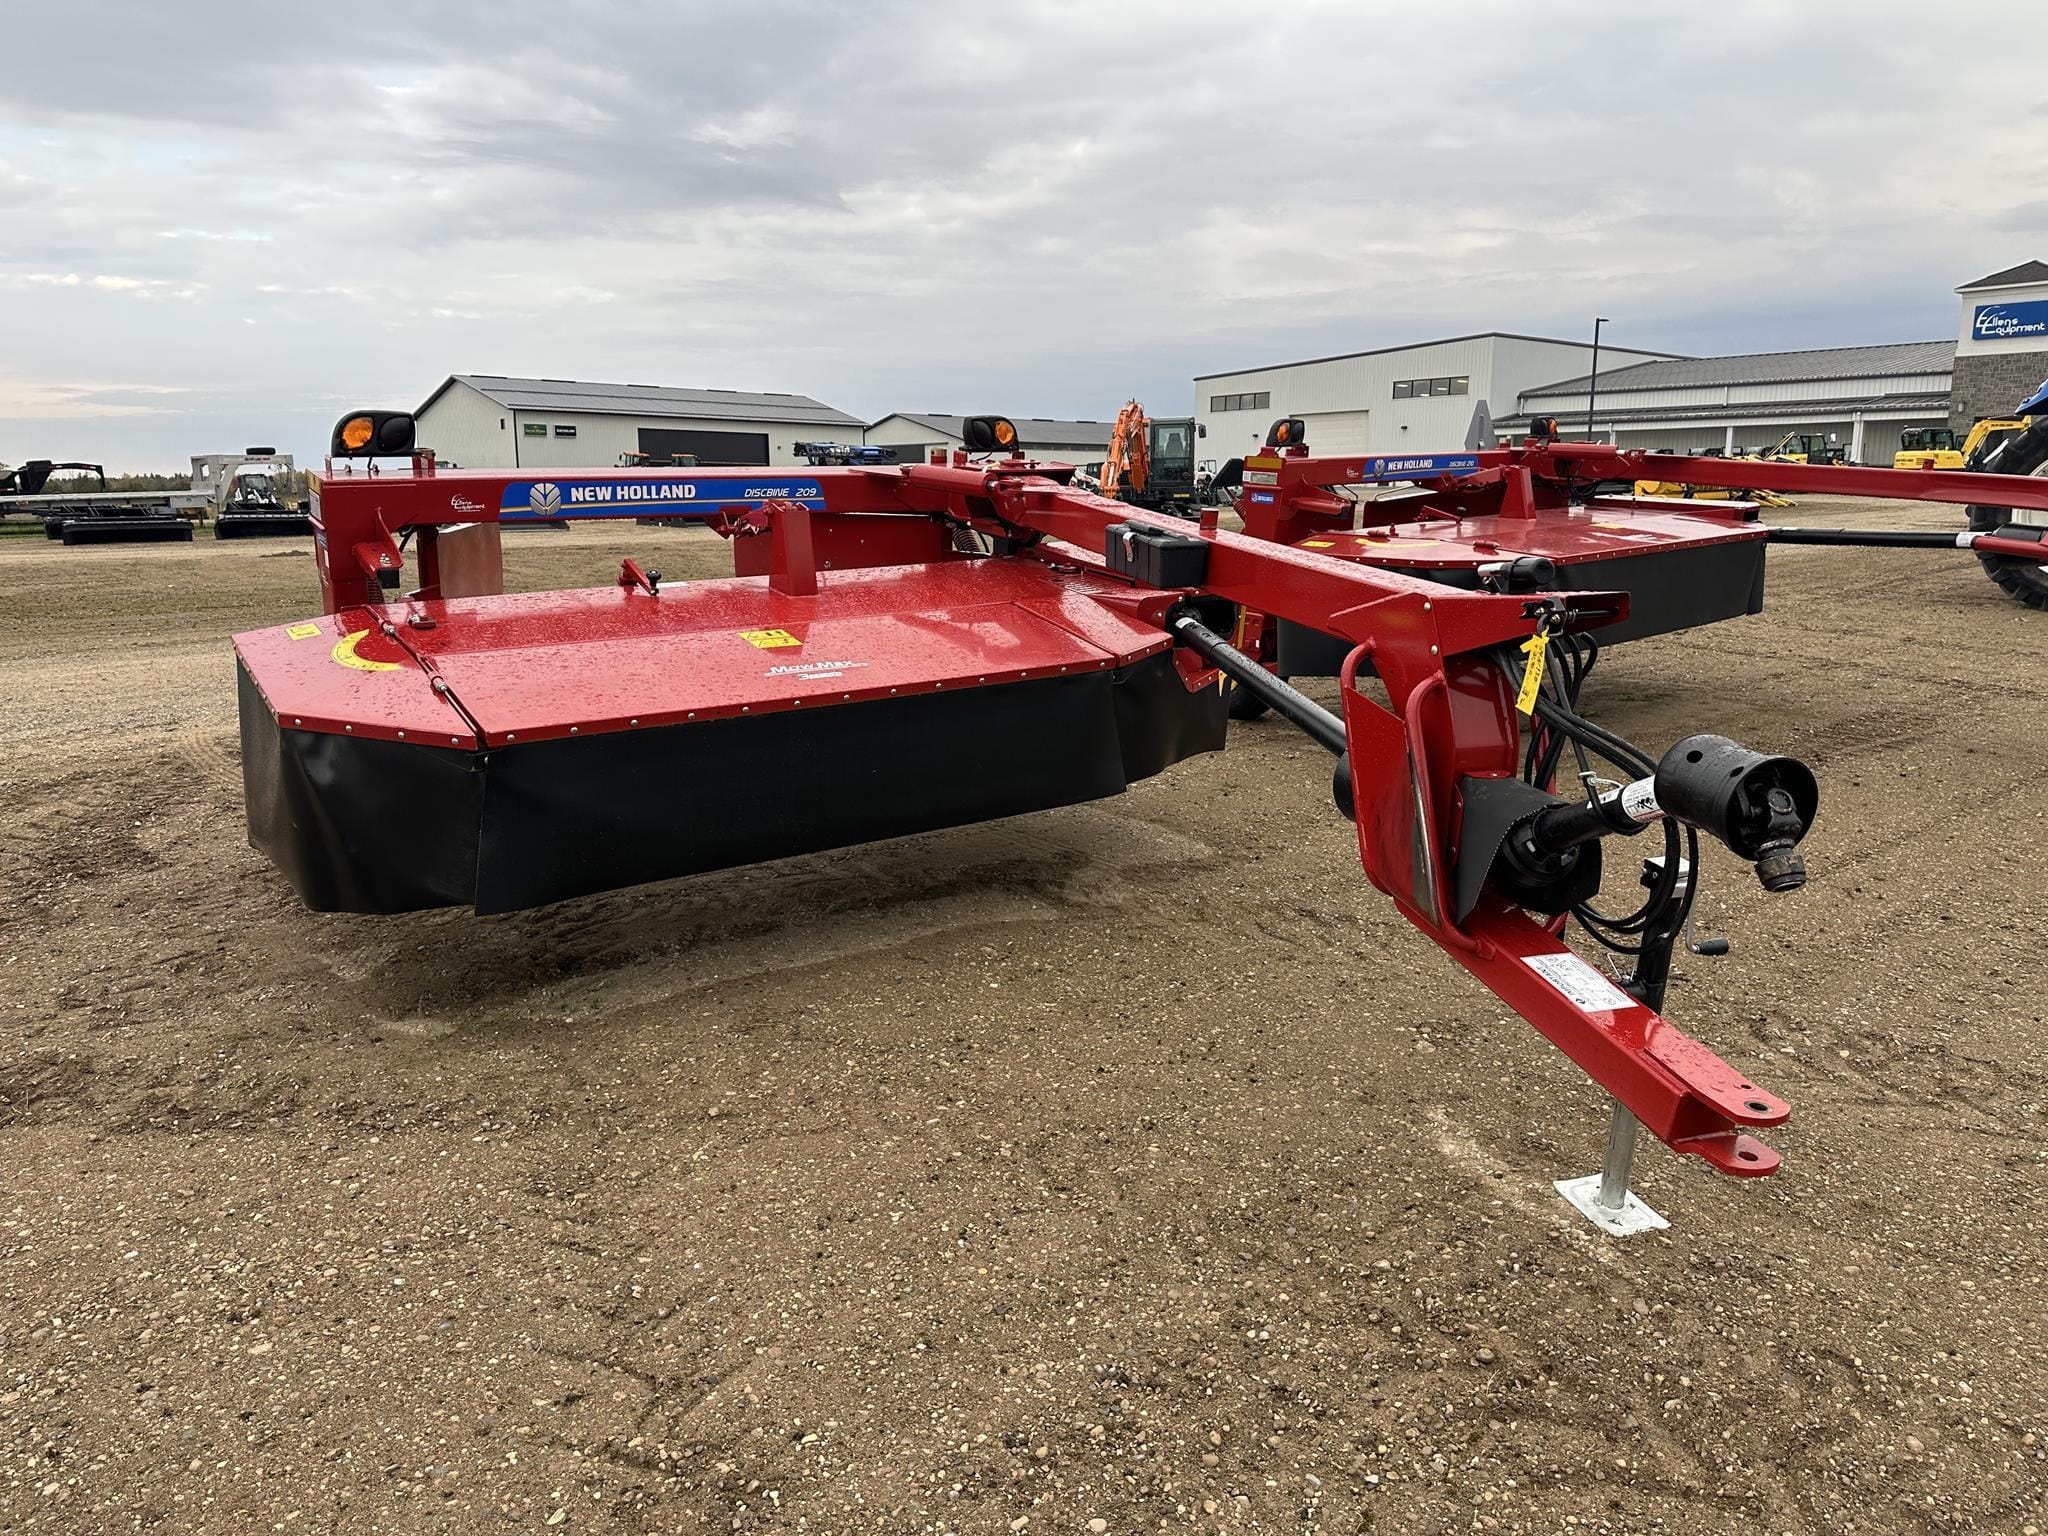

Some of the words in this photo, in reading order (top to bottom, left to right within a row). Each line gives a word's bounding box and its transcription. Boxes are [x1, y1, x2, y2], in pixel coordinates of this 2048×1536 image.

[1976, 306, 2019, 328] Ellens
[1981, 310, 2046, 335] Equipment
[1387, 461, 1402, 471] NEW
[1403, 459, 1433, 470] HOLLAND
[570, 486, 612, 503] NEW
[616, 484, 696, 501] HOLLAND
[744, 488, 790, 498] DISCBINE
[795, 488, 817, 497] 209
